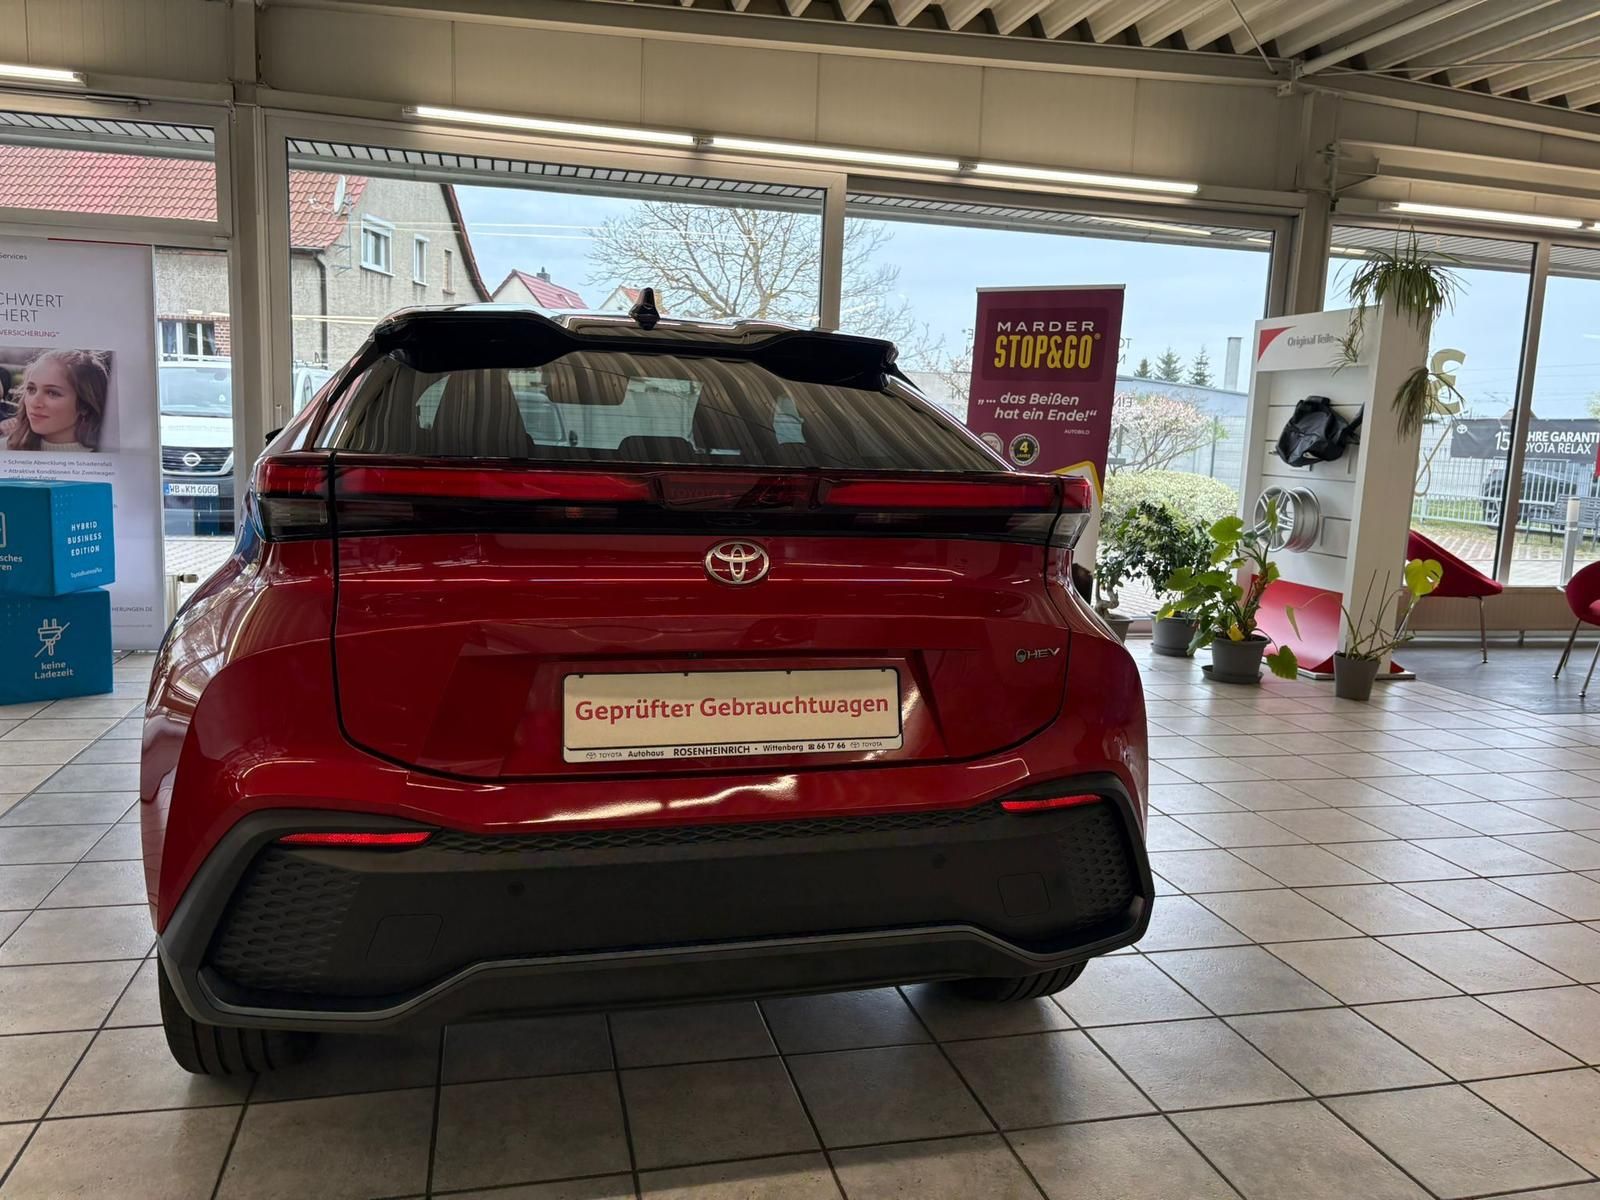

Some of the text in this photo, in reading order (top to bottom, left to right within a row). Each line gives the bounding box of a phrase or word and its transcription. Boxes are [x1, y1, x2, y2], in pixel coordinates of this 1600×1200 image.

[997, 321, 1094, 332] MARDER
[1287, 334, 1316, 348] Original
[1000, 392, 1026, 404] das
[1029, 393, 1079, 406] Beißen
[994, 407, 1020, 419] hat
[1023, 407, 1043, 420] ein
[1020, 441, 1029, 453] 4
[1494, 431, 1512, 451] 15
[1527, 431, 1549, 442] HRE
[1558, 442, 1592, 455] RELAX
[71, 521, 97, 531] HYBRID
[67, 532, 102, 545] BUSINESS
[71, 545, 100, 556] EDITION
[41, 661, 66, 671] keine
[34, 668, 75, 680] Ladezeit
[575, 696, 889, 725] Geprüfter Gebrauchtwagen
[627, 749, 665, 758] Autohaus
[673, 745, 750, 756] ROSENHEINRICH
[762, 743, 804, 753] Wittenberg
[816, 742, 826, 750] 66
[827, 742, 834, 750] 17
[836, 742, 846, 750] 66
